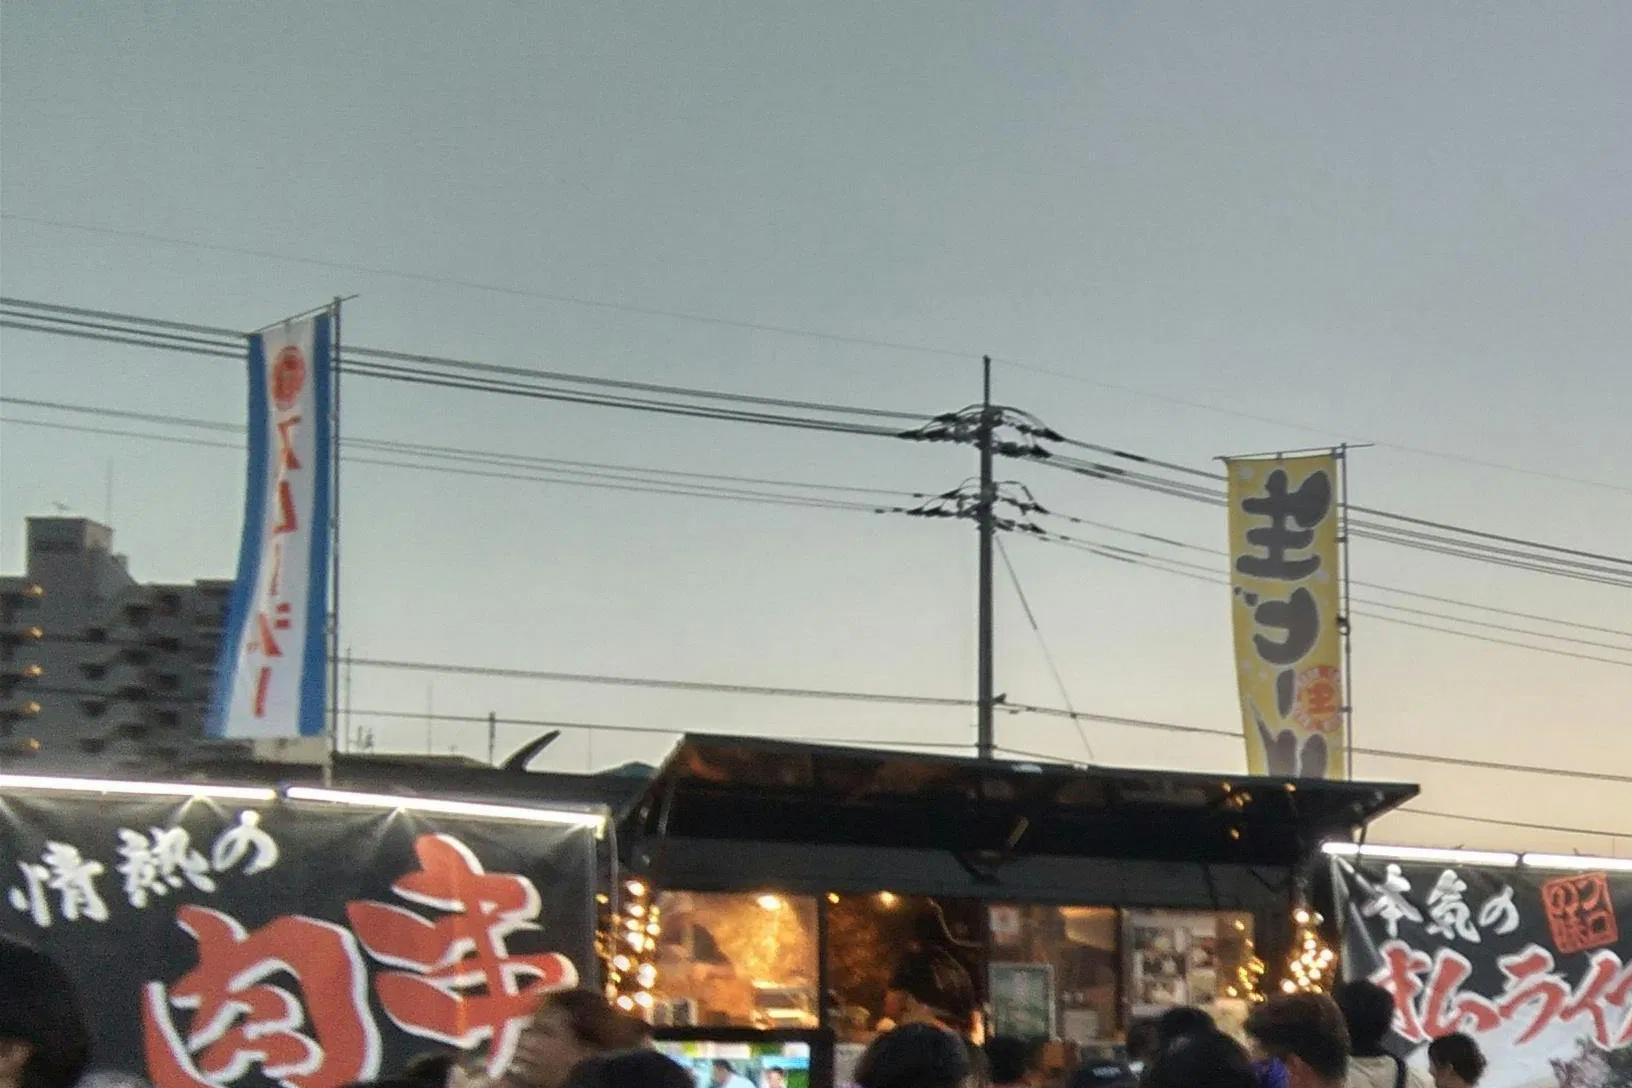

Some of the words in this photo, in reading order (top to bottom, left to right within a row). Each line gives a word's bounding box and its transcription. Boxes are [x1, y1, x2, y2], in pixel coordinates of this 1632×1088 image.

[10, 809, 279, 928] 情熱の
[1362, 863, 1520, 943] 本気の
